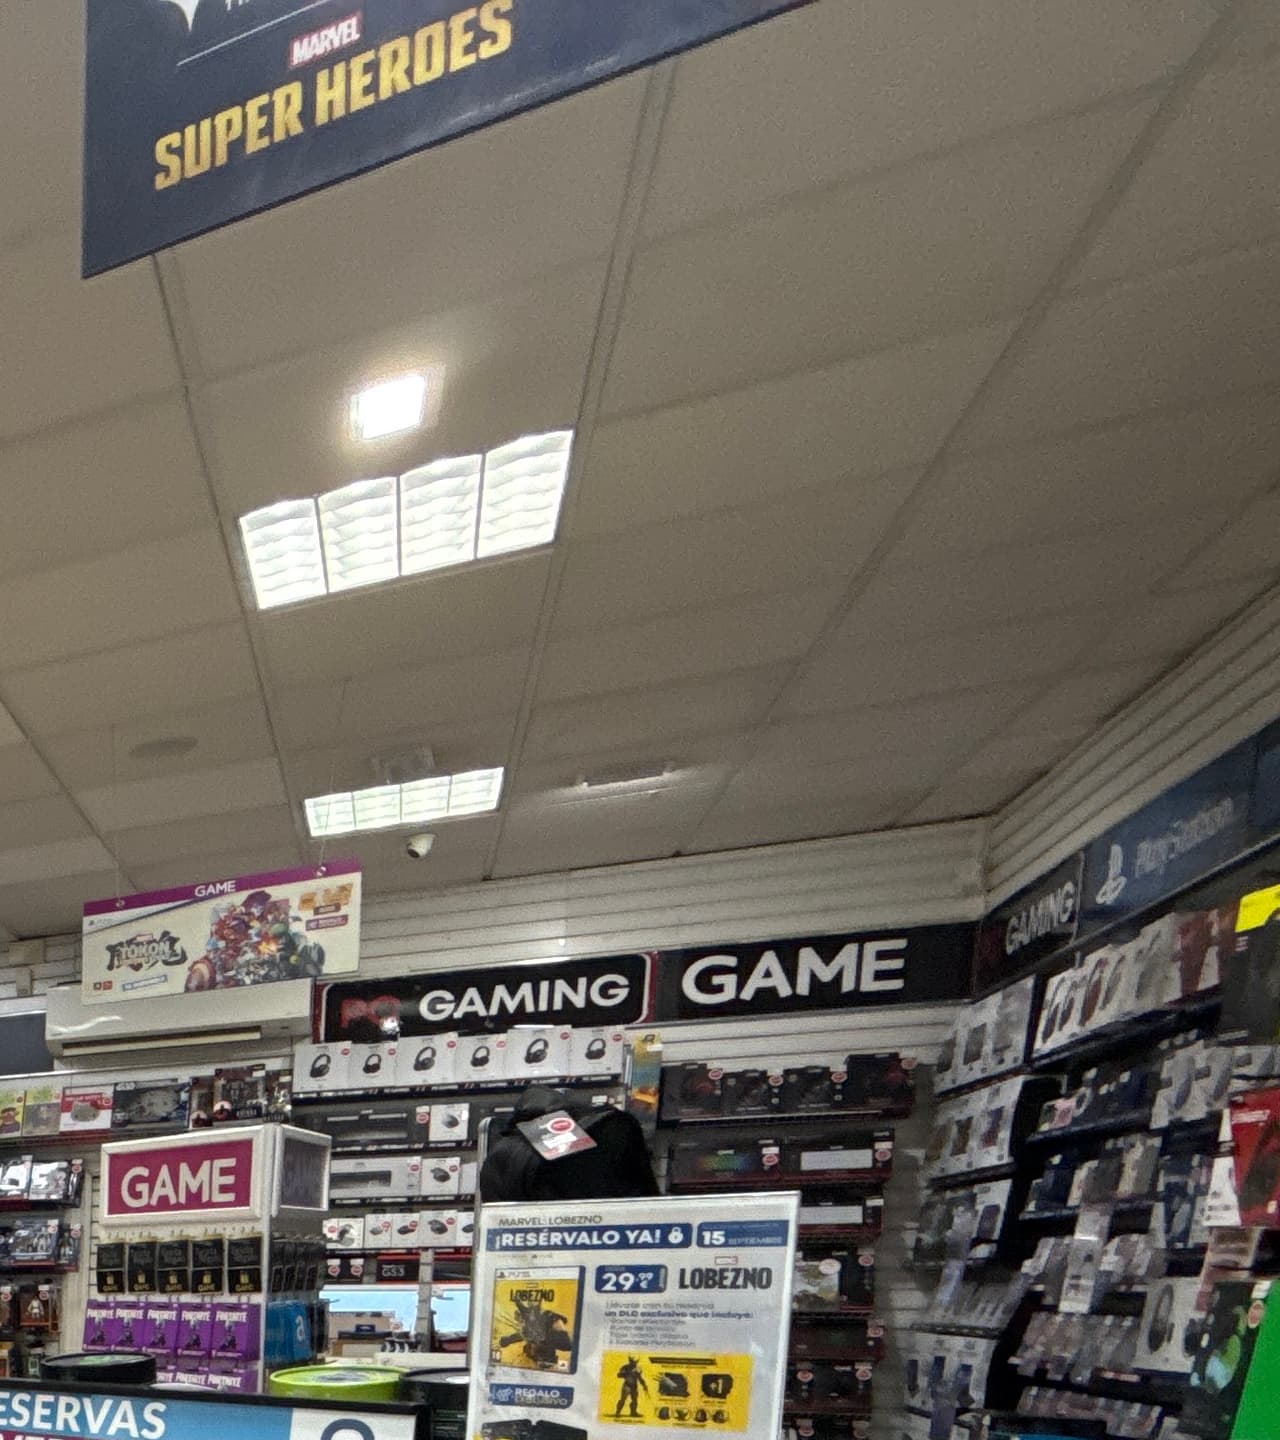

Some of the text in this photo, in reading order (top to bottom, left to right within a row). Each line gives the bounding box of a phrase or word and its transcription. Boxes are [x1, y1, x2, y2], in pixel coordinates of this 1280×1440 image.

[290, 16, 361, 67] MARVEL
[154, 0, 513, 191] SUPER HEROES
[195, 880, 236, 897] GAME
[1005, 881, 1075, 957] GAMING
[681, 938, 909, 1006] GAME
[419, 973, 630, 1023] GAMING
[120, 1157, 238, 1208] GAME
[495, 1229, 725, 1248] ¡RESÉRVALO YA! 15
[499, 1215, 602, 1226] MARVEL LOBEZNO
[510, 1289, 554, 1302] LOBEZNO
[679, 1267, 773, 1290] LOBEZNO
